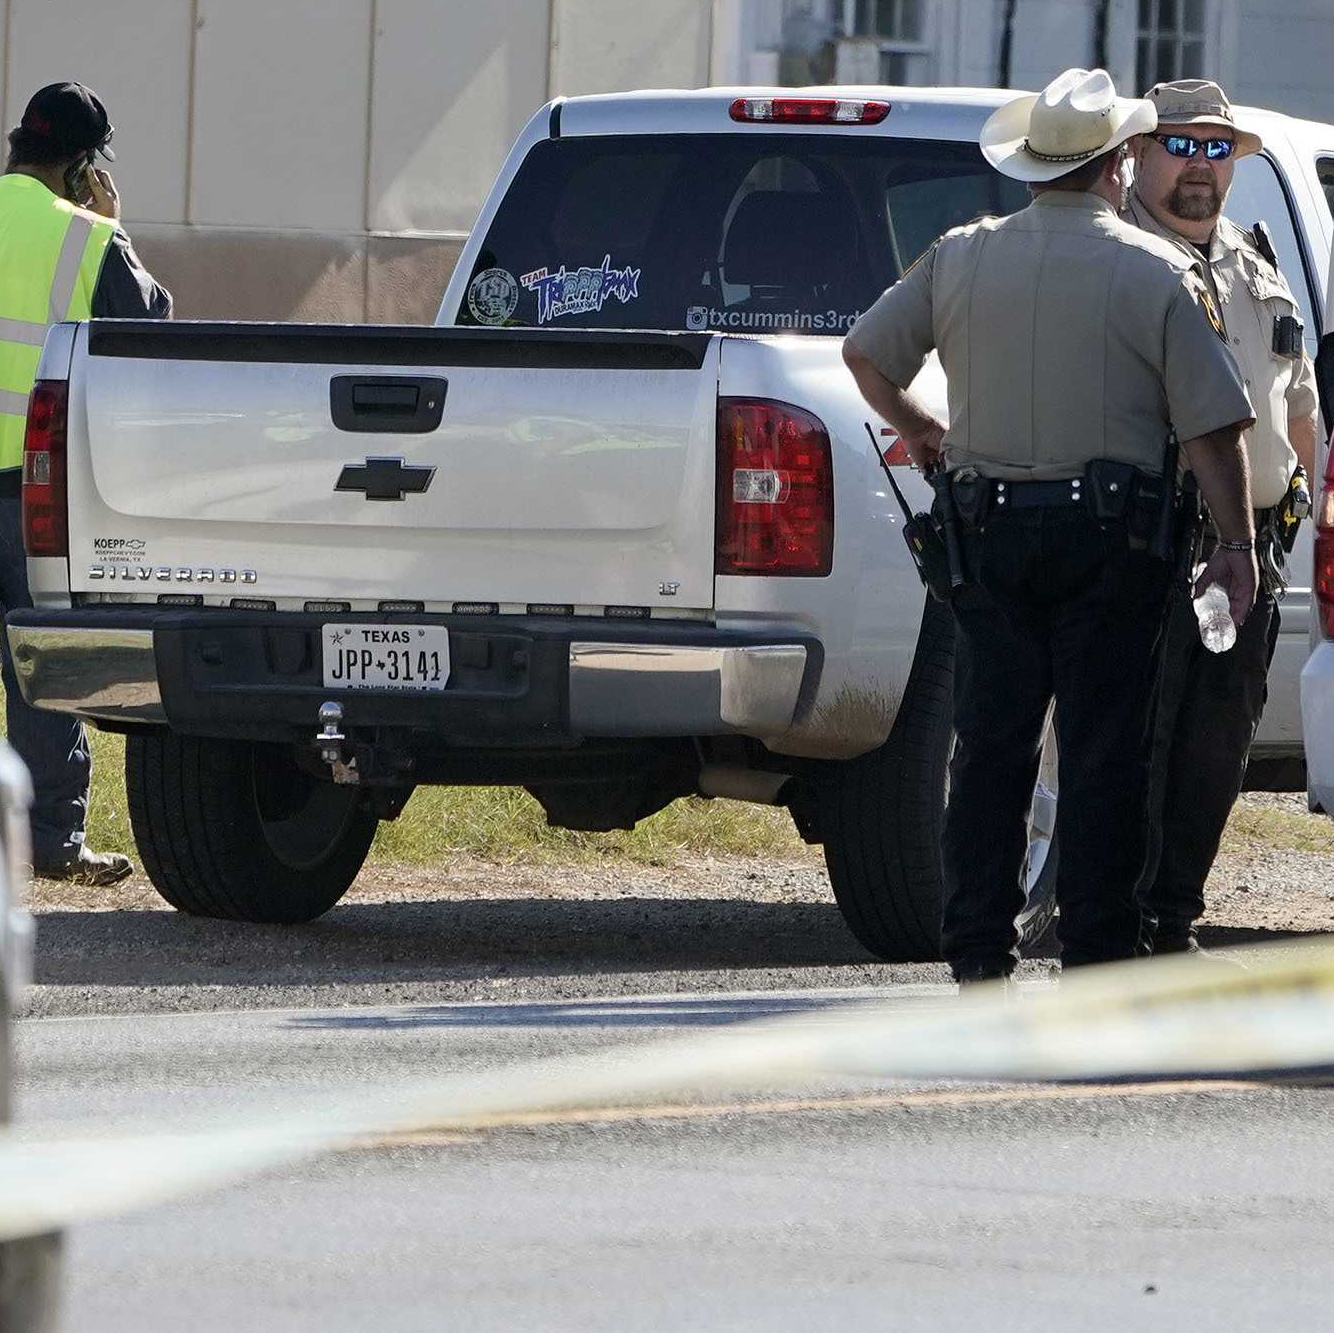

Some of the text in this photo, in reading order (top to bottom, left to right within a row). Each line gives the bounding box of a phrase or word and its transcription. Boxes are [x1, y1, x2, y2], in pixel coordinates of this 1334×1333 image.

[520, 267, 548, 286] TEAM
[93, 538, 126, 549] KOEPP
[89, 564, 259, 584] SILVERADO
[361, 630, 411, 644] TEXAS
